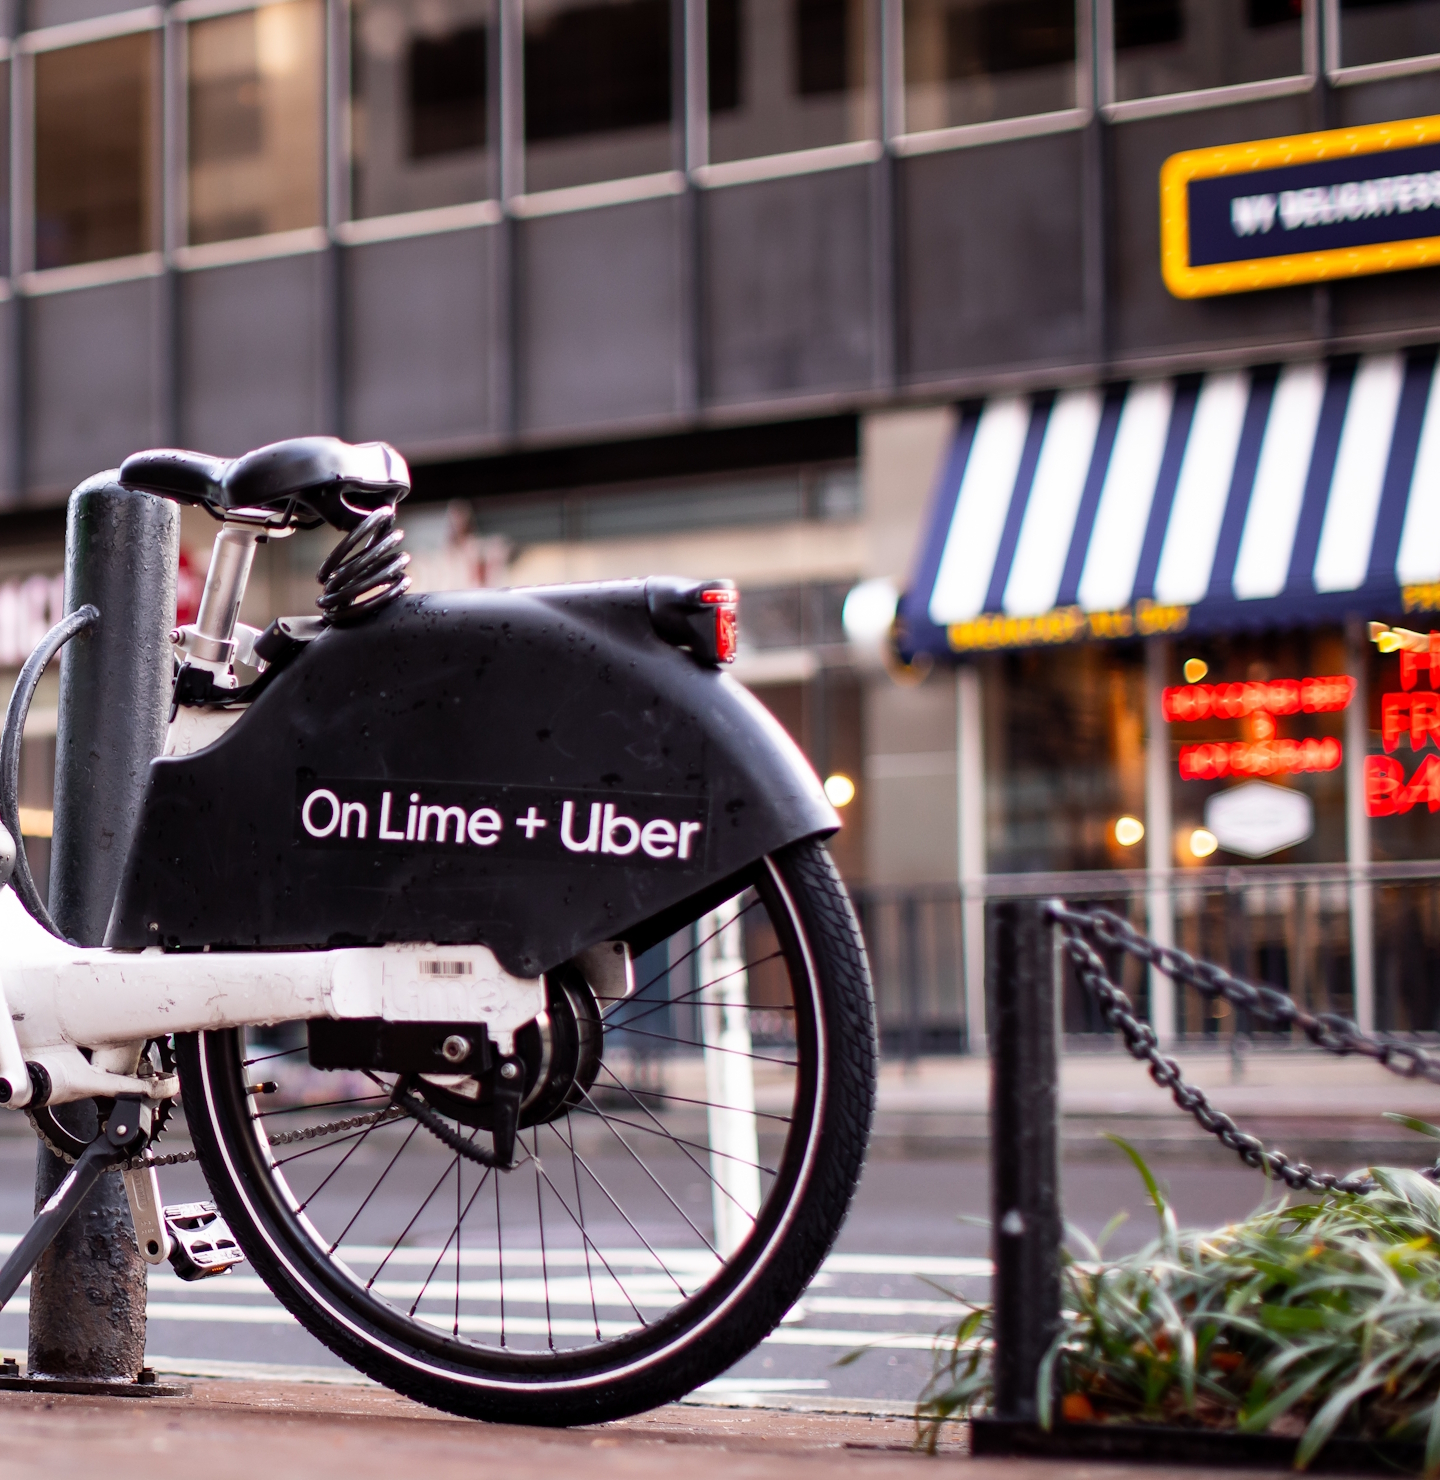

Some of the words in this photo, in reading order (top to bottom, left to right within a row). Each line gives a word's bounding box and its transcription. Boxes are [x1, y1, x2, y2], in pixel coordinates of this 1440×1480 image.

[301, 788, 367, 839] On
[378, 791, 502, 846] Lime
[560, 800, 702, 860] Uber
